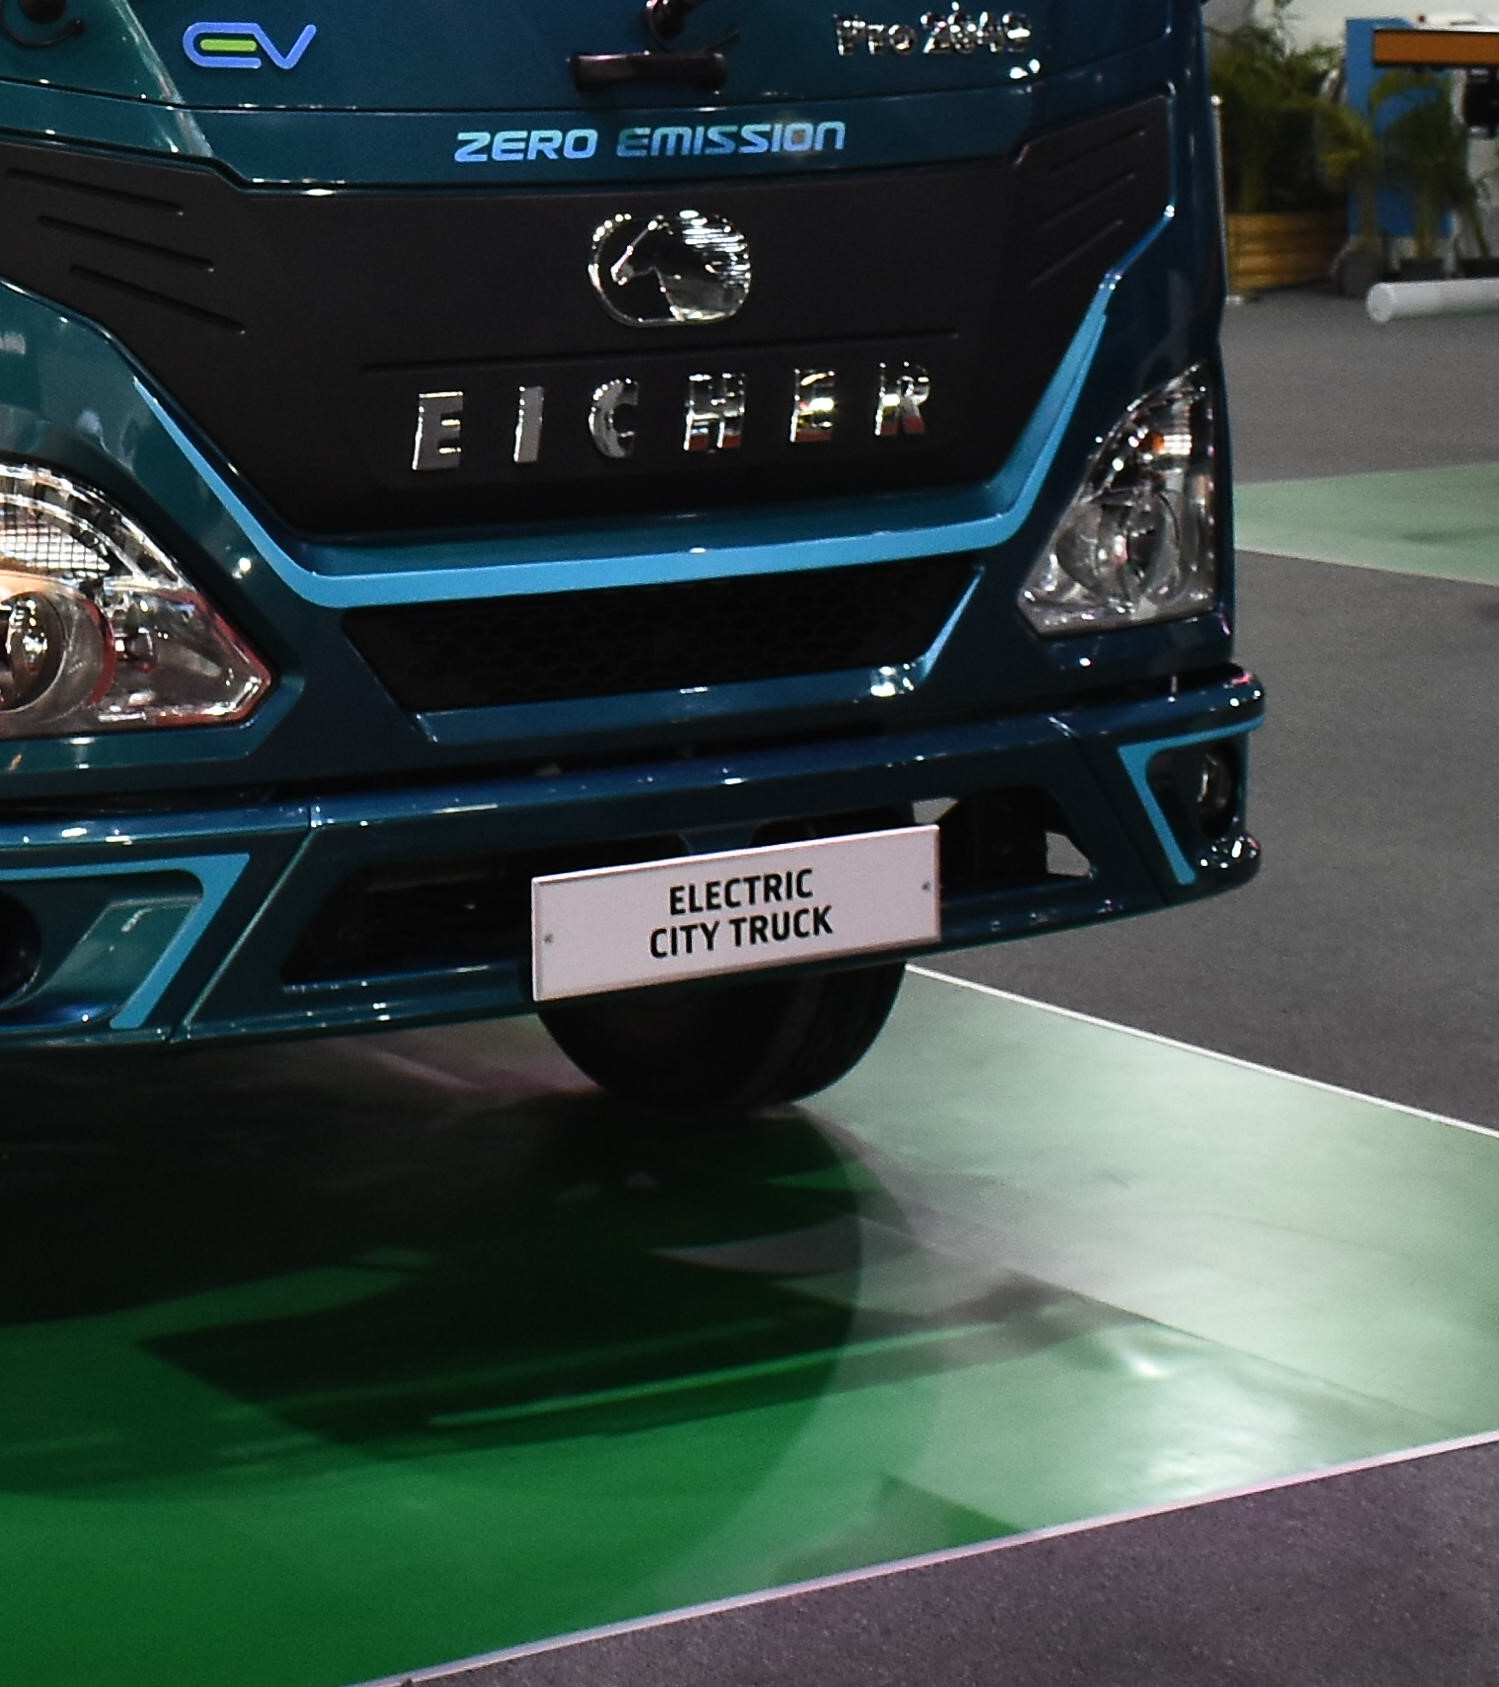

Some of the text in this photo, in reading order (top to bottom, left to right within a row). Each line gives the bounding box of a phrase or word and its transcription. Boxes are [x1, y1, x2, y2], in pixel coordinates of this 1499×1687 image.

[182, 21, 317, 69] EV
[834, 14, 916, 56] Pro
[454, 121, 846, 163] ZERO EMISSION
[412, 362, 931, 471] EICHER
[669, 868, 814, 915] ELECTRIC
[650, 905, 834, 959] CITY TRUCK
